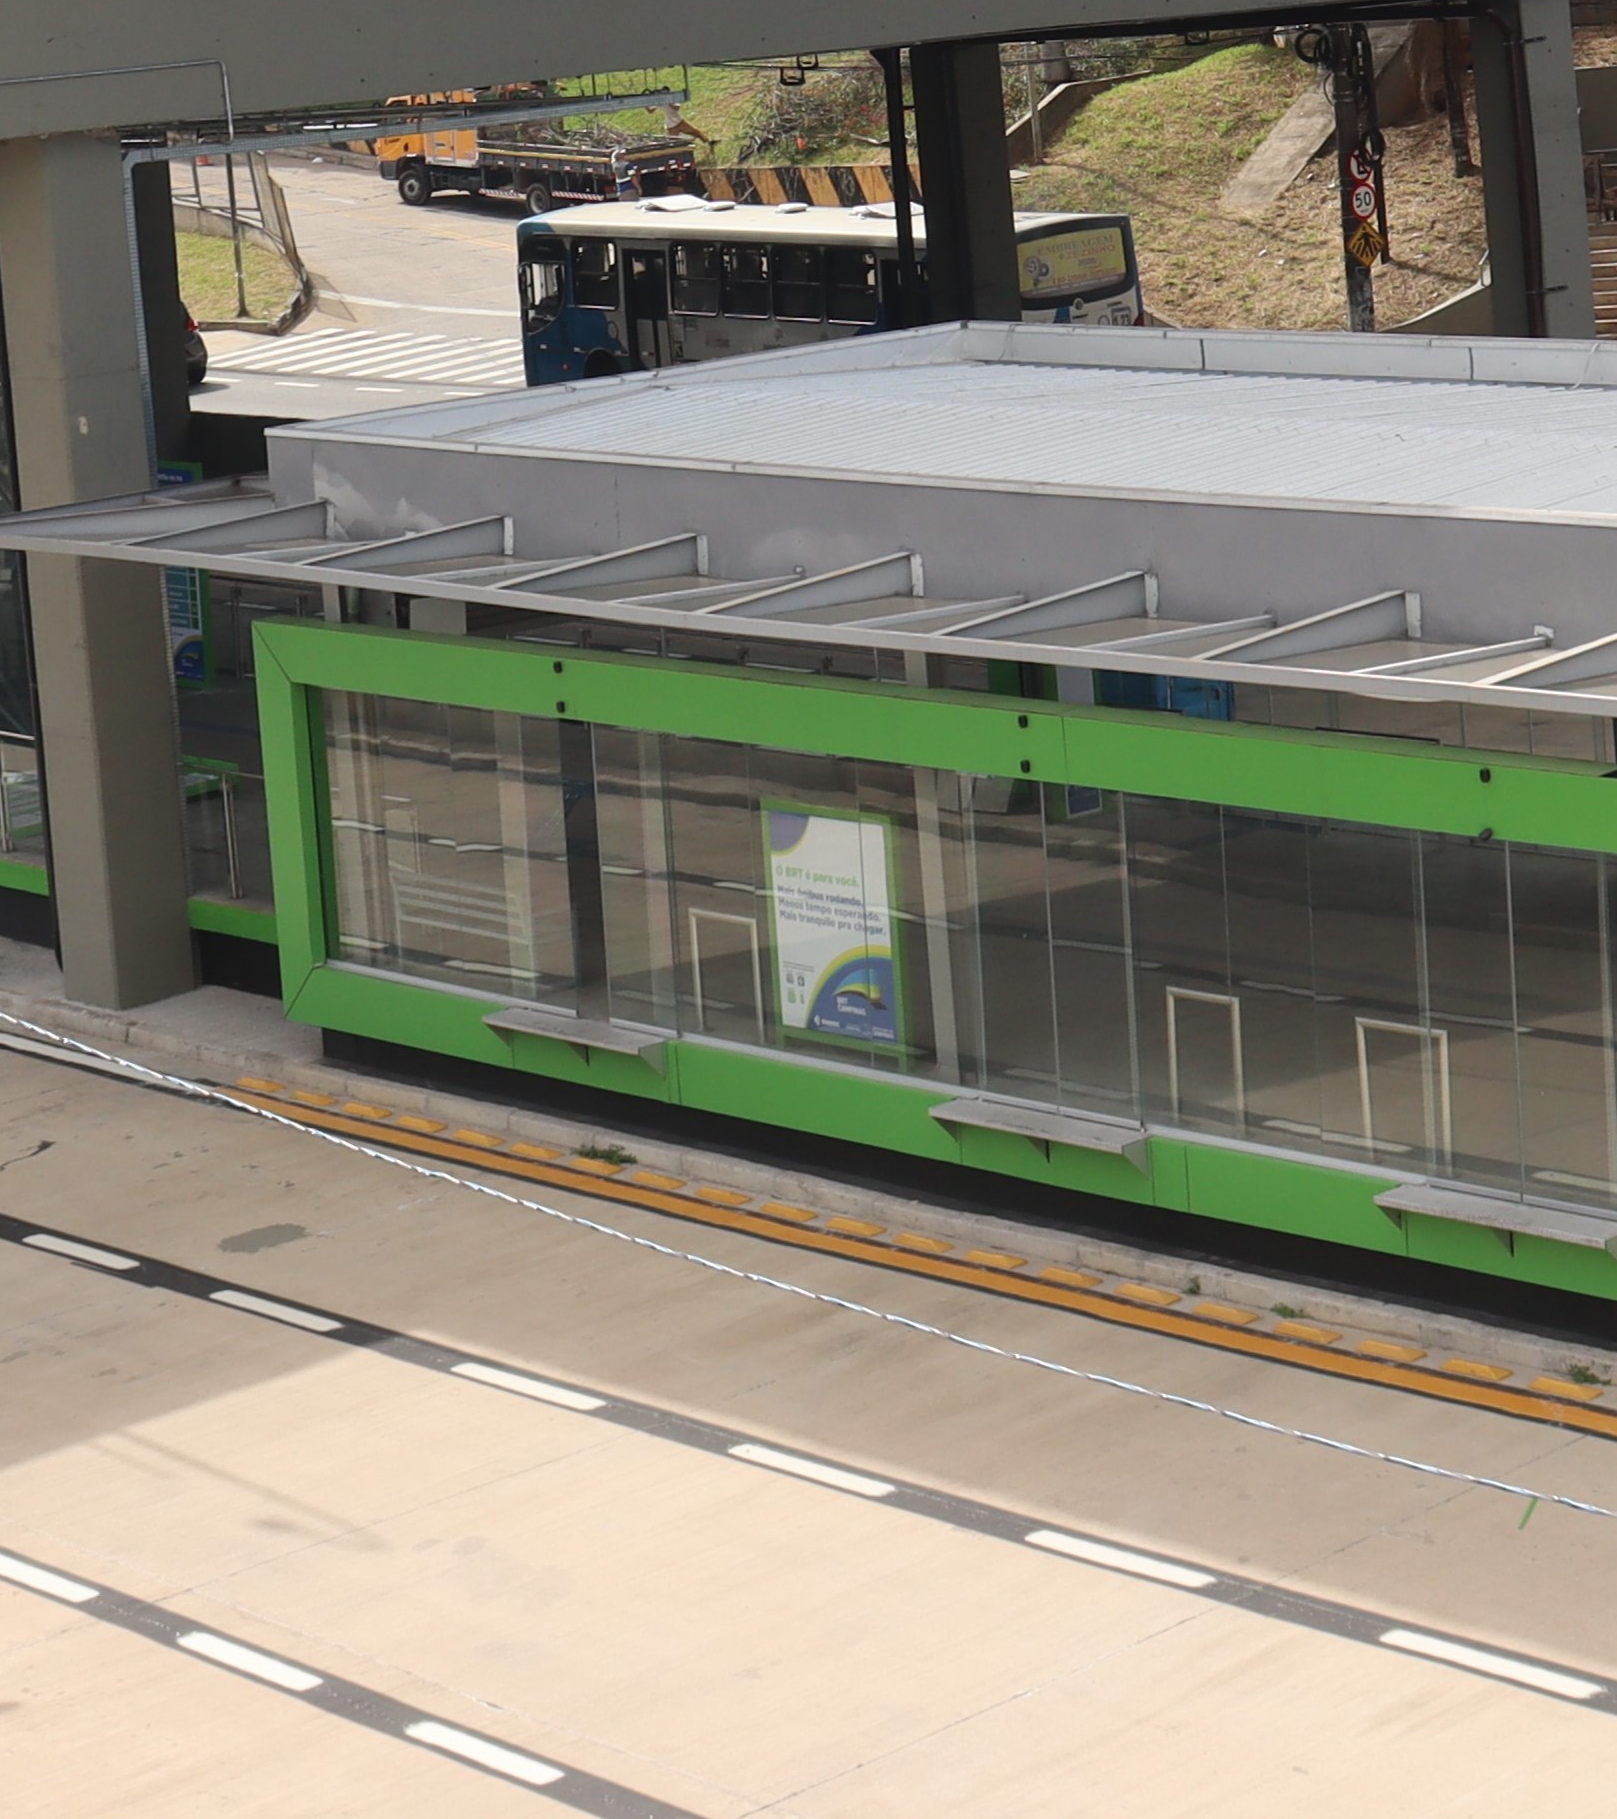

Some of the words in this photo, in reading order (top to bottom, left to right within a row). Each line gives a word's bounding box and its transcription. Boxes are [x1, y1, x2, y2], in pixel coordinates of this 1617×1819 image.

[1355, 191, 1372, 208] 50
[776, 865, 783, 875] O
[786, 866, 803, 879] BRT
[813, 872, 833, 884] para
[778, 896, 803, 910] Menos
[805, 901, 833, 915] tempo
[779, 909, 797, 921] Mais
[798, 913, 836, 927] tranquilo
[837, 921, 851, 931] pra
